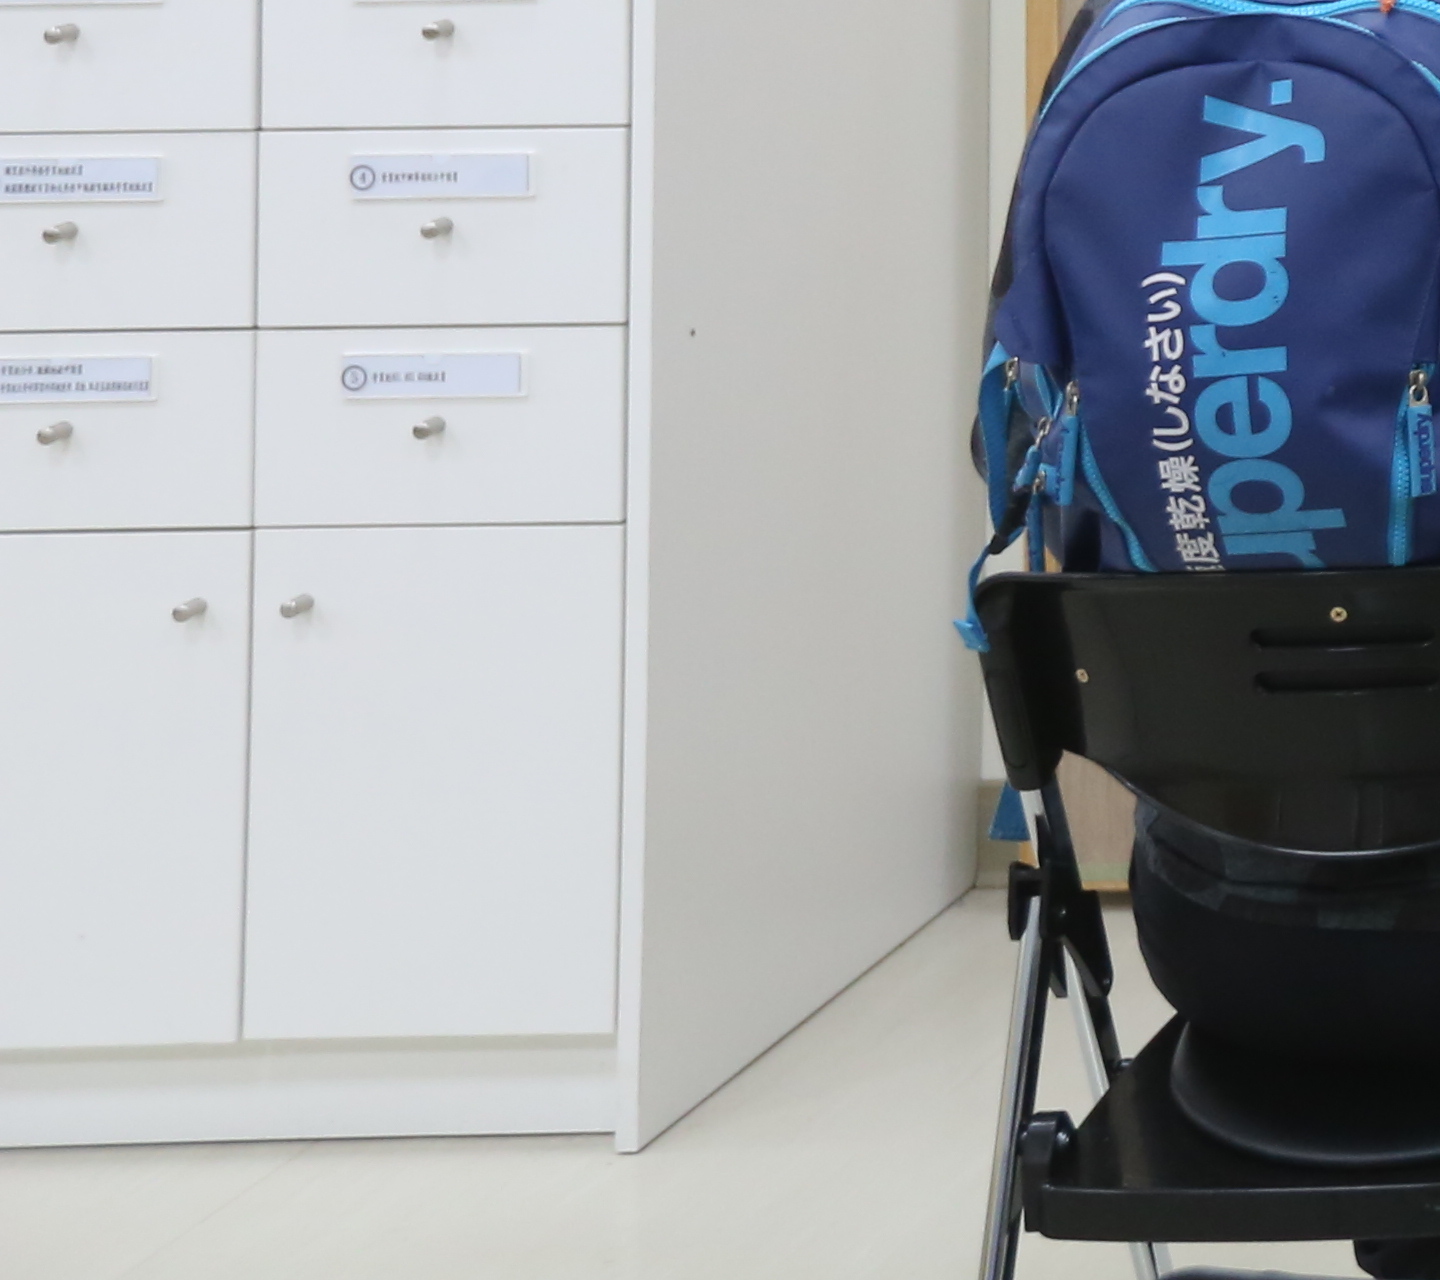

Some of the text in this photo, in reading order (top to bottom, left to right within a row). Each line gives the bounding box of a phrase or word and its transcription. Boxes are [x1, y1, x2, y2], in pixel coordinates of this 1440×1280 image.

[1141, 272, 1227, 570] 度乾燥(しなさい)
